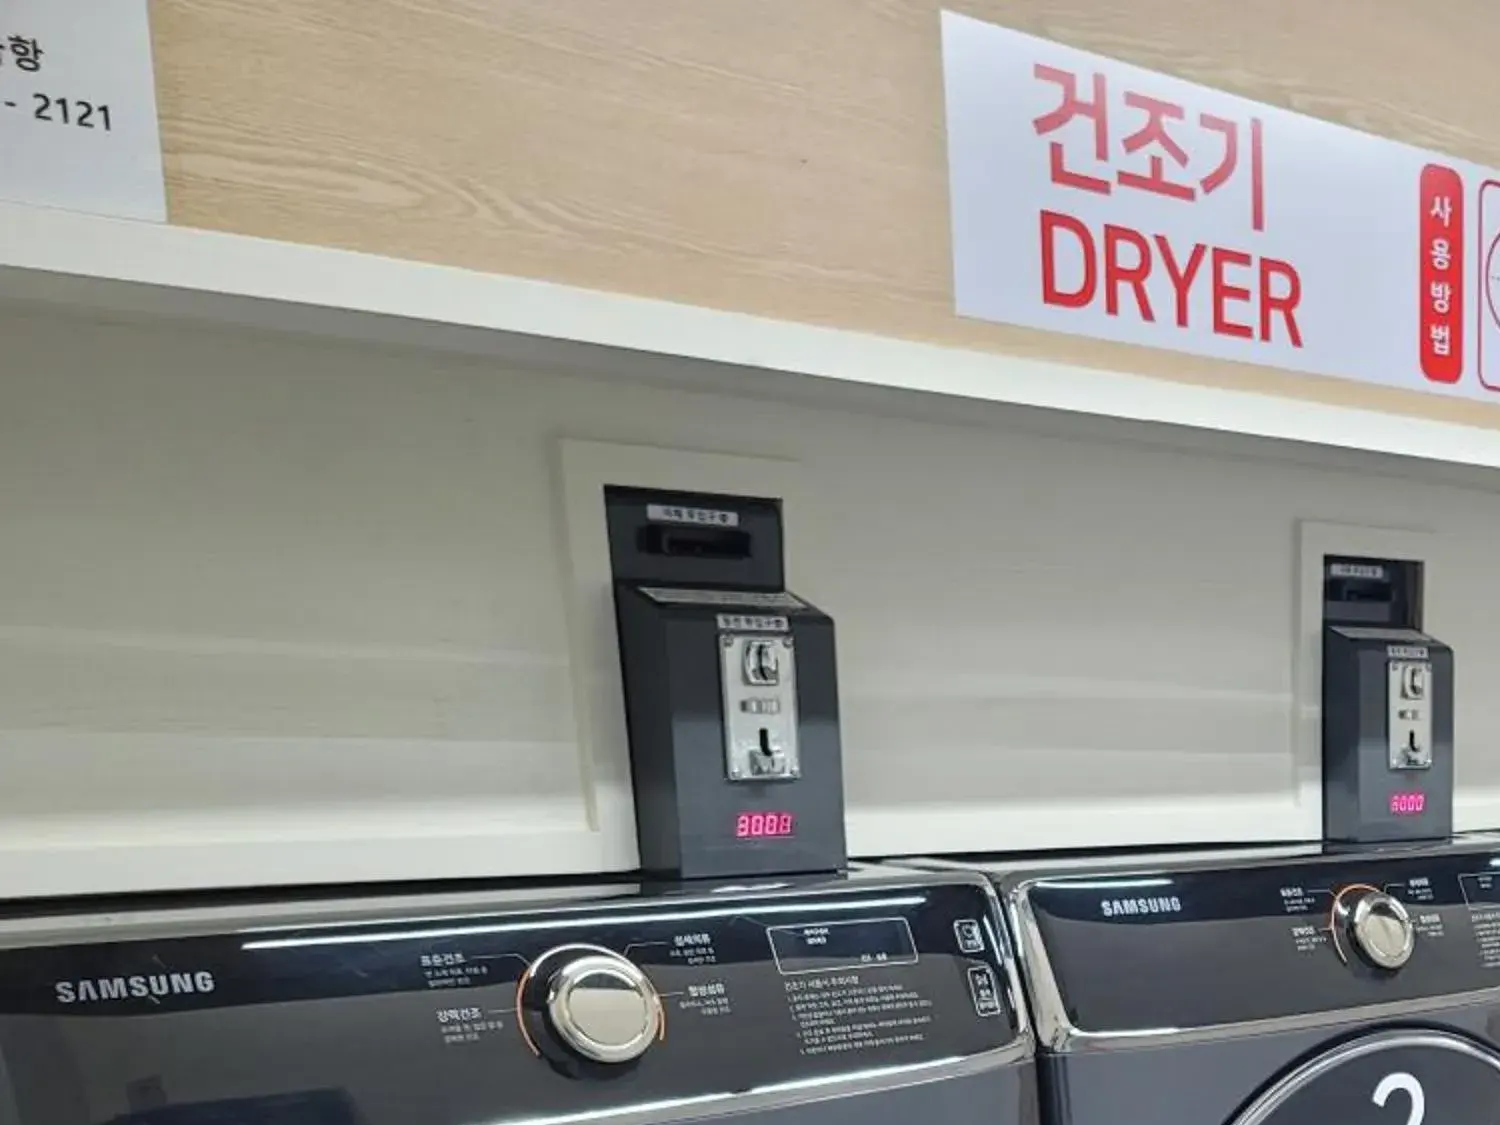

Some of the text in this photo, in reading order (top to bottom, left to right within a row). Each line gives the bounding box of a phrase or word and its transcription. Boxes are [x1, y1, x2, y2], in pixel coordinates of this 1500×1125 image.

[0, 35, 44, 72] 항
[33, 93, 111, 131] 2121
[1032, 62, 1264, 232] 건조기
[1040, 209, 1303, 348] DRYER
[1101, 896, 1181, 917] SAMSUNG
[54, 971, 215, 1003] SAMSUNG
